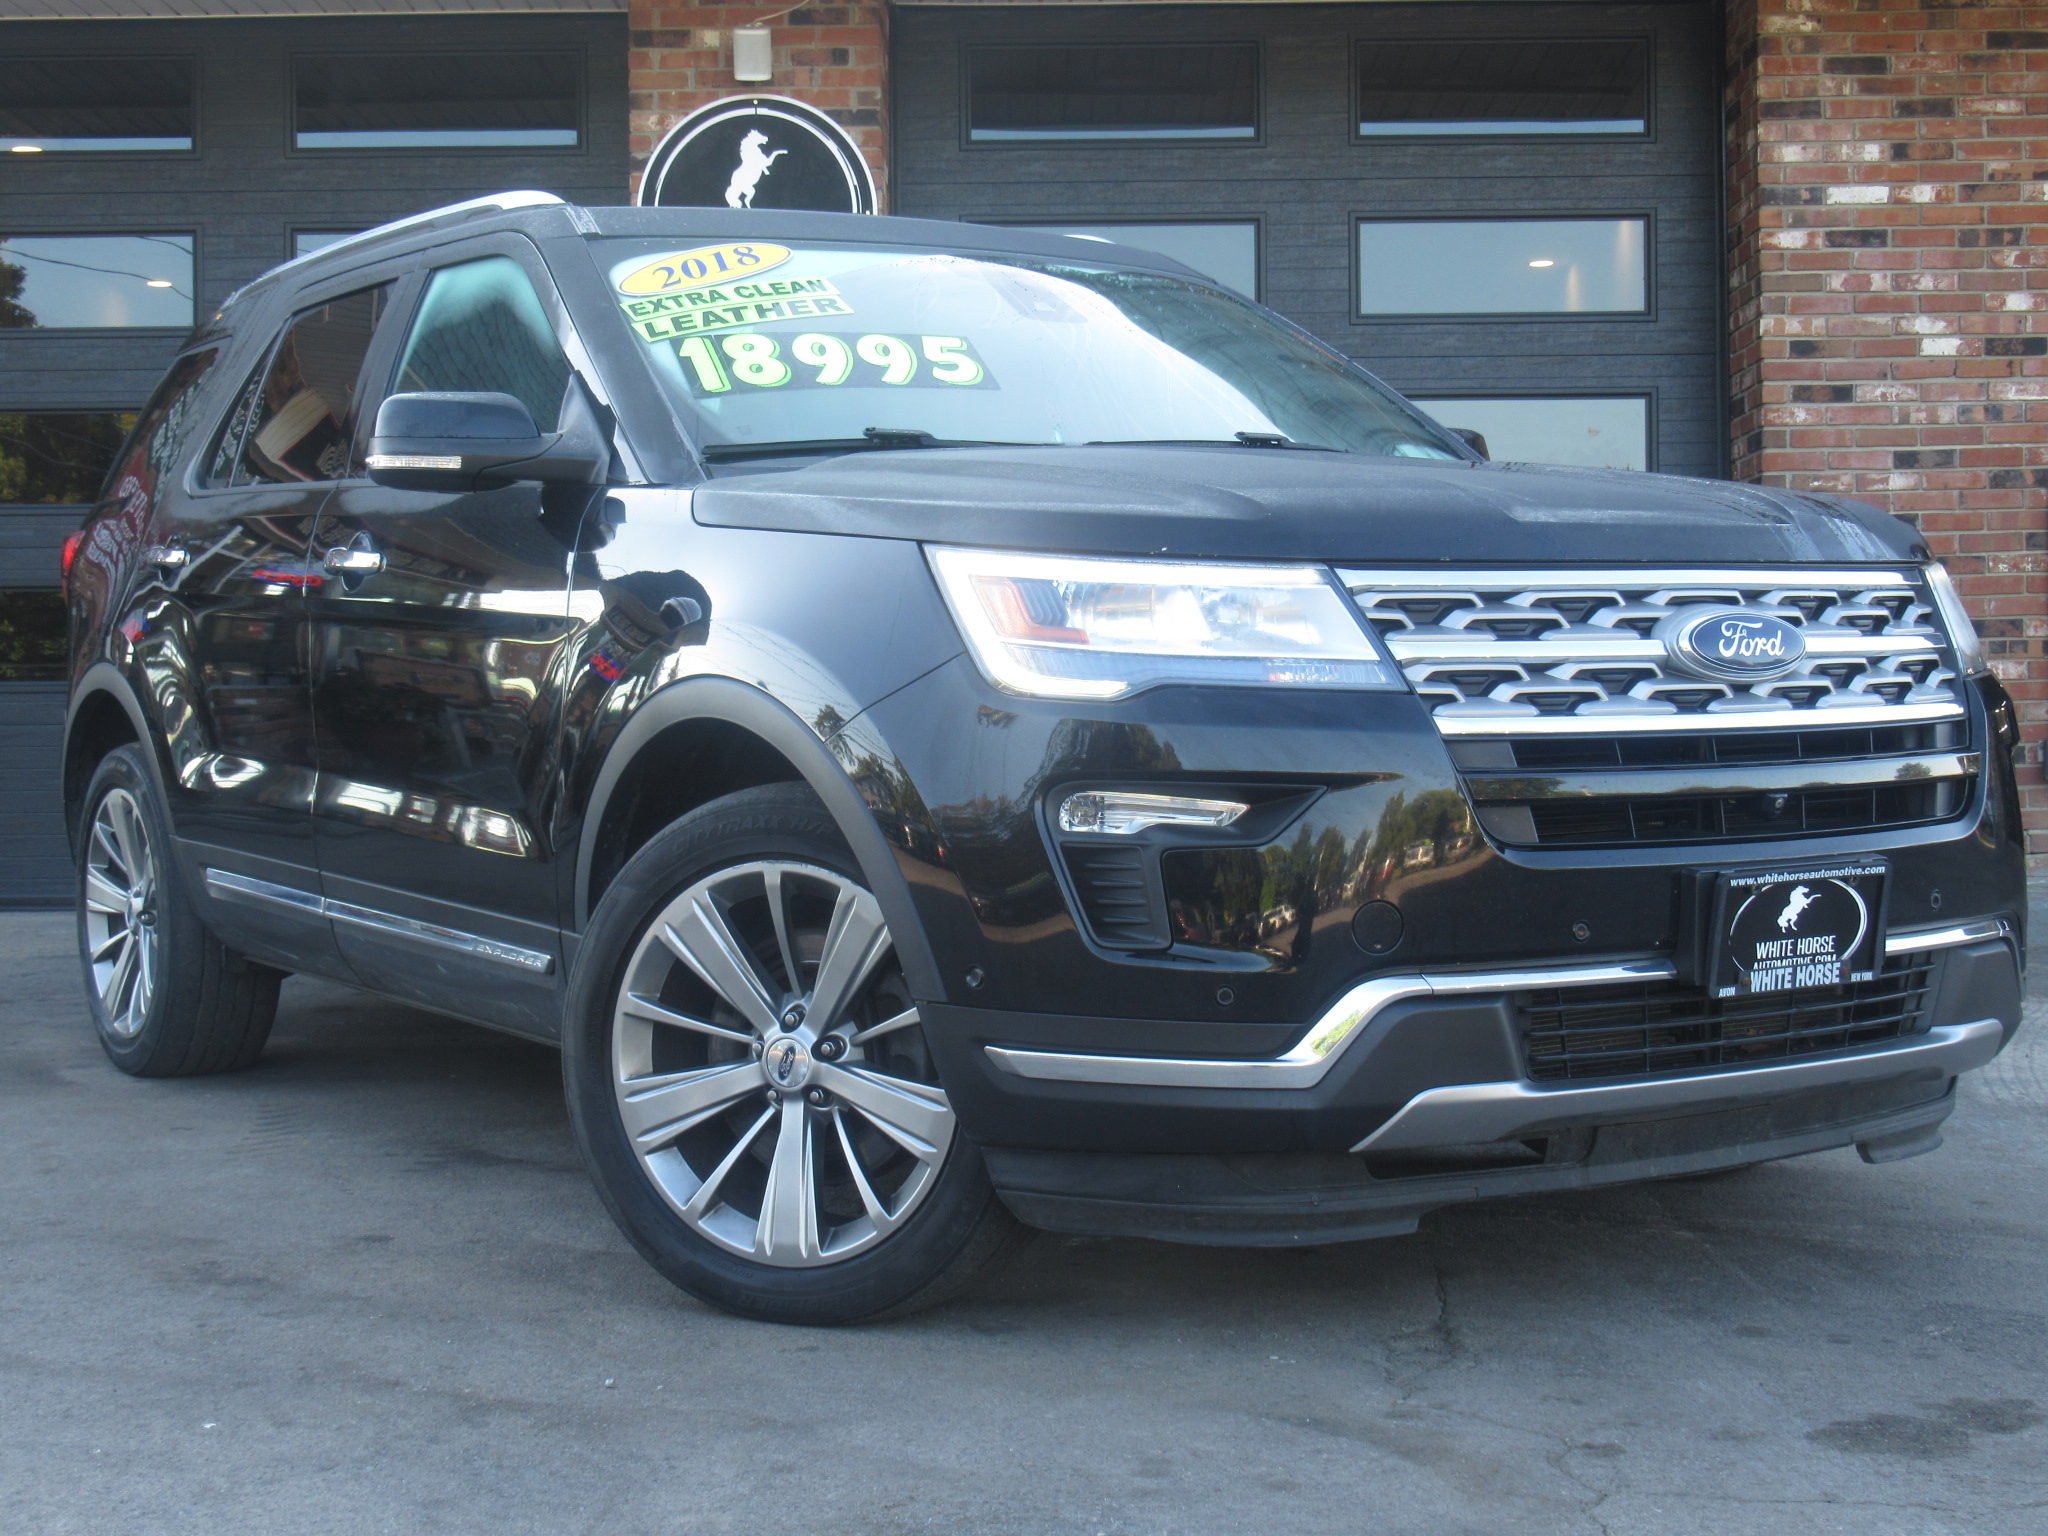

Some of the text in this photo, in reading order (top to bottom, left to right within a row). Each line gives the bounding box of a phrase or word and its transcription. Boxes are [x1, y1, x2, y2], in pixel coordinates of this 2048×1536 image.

[652, 245, 762, 290] 2018
[627, 278, 828, 319] EXTRA CLEAN
[643, 296, 845, 339] LEATHER
[678, 332, 985, 394] 18995
[1718, 620, 1785, 657] Ford
[1730, 865, 1886, 887] www.whitehorseautomotive.com
[476, 944, 542, 967] EXPLORER
[1756, 935, 1837, 960] WHITE HORSE
[1753, 953, 1837, 970] AUTOMOTIVECOM
[1718, 979, 1736, 998] AVON
[1750, 962, 1841, 993] WHITE HORSE
[1850, 972, 1861, 982] NEW
[780, 1051, 795, 1076] Ford
